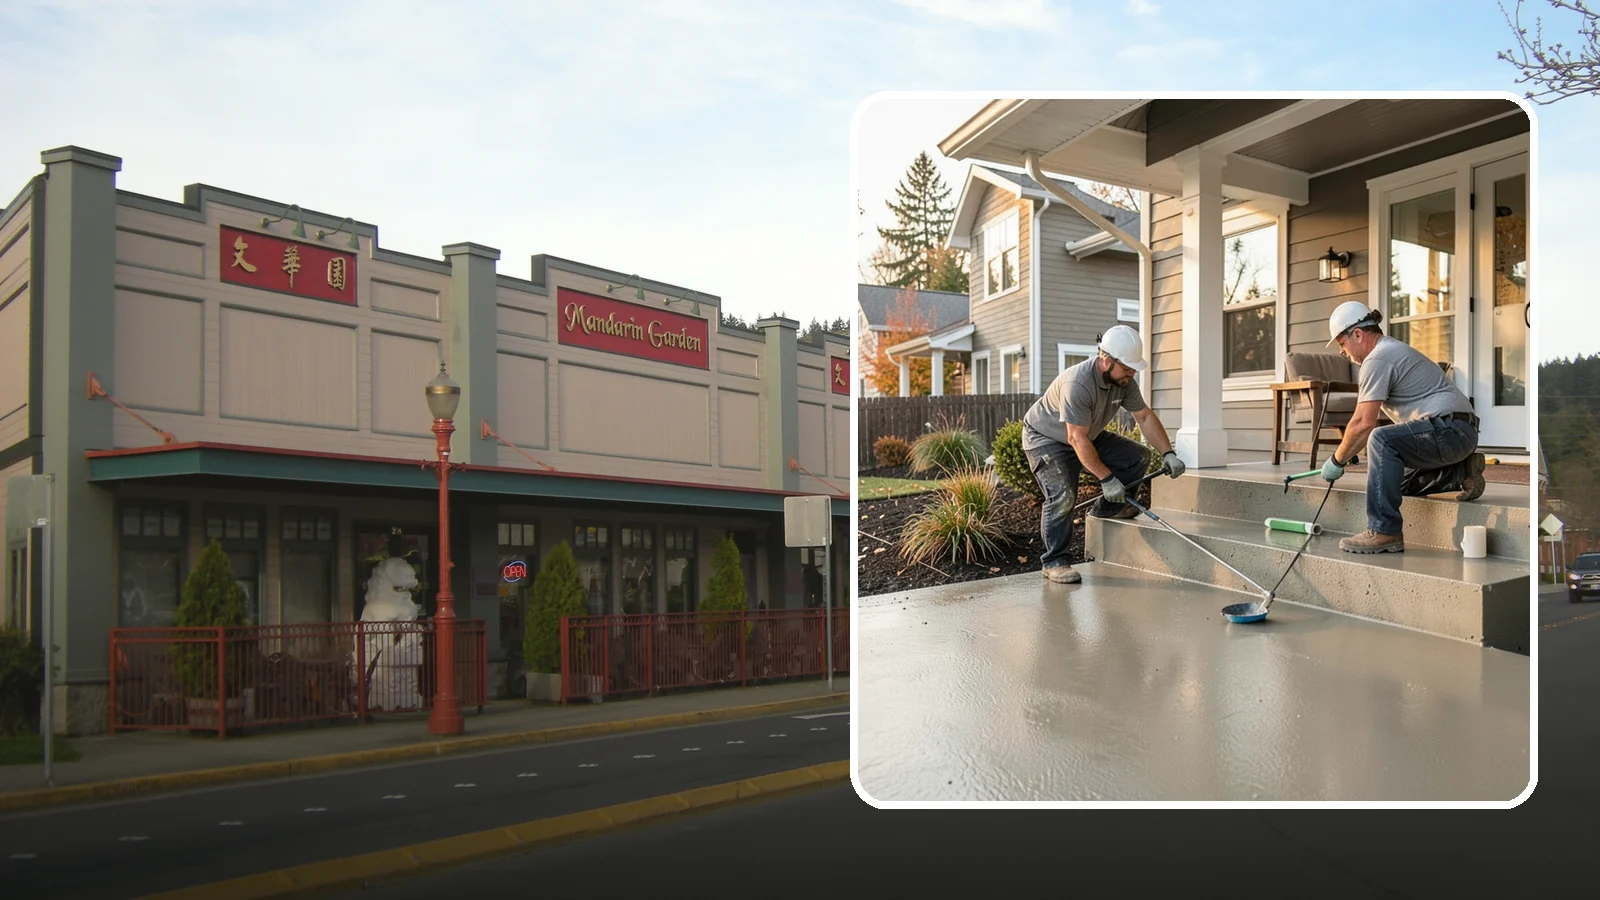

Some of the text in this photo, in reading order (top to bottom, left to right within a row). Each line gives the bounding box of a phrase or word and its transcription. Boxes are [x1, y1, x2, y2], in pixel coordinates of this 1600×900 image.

[231, 235, 346, 290] 文華園
[564, 302, 701, 352] Mandarin Garden
[503, 565, 527, 578] OPEN
